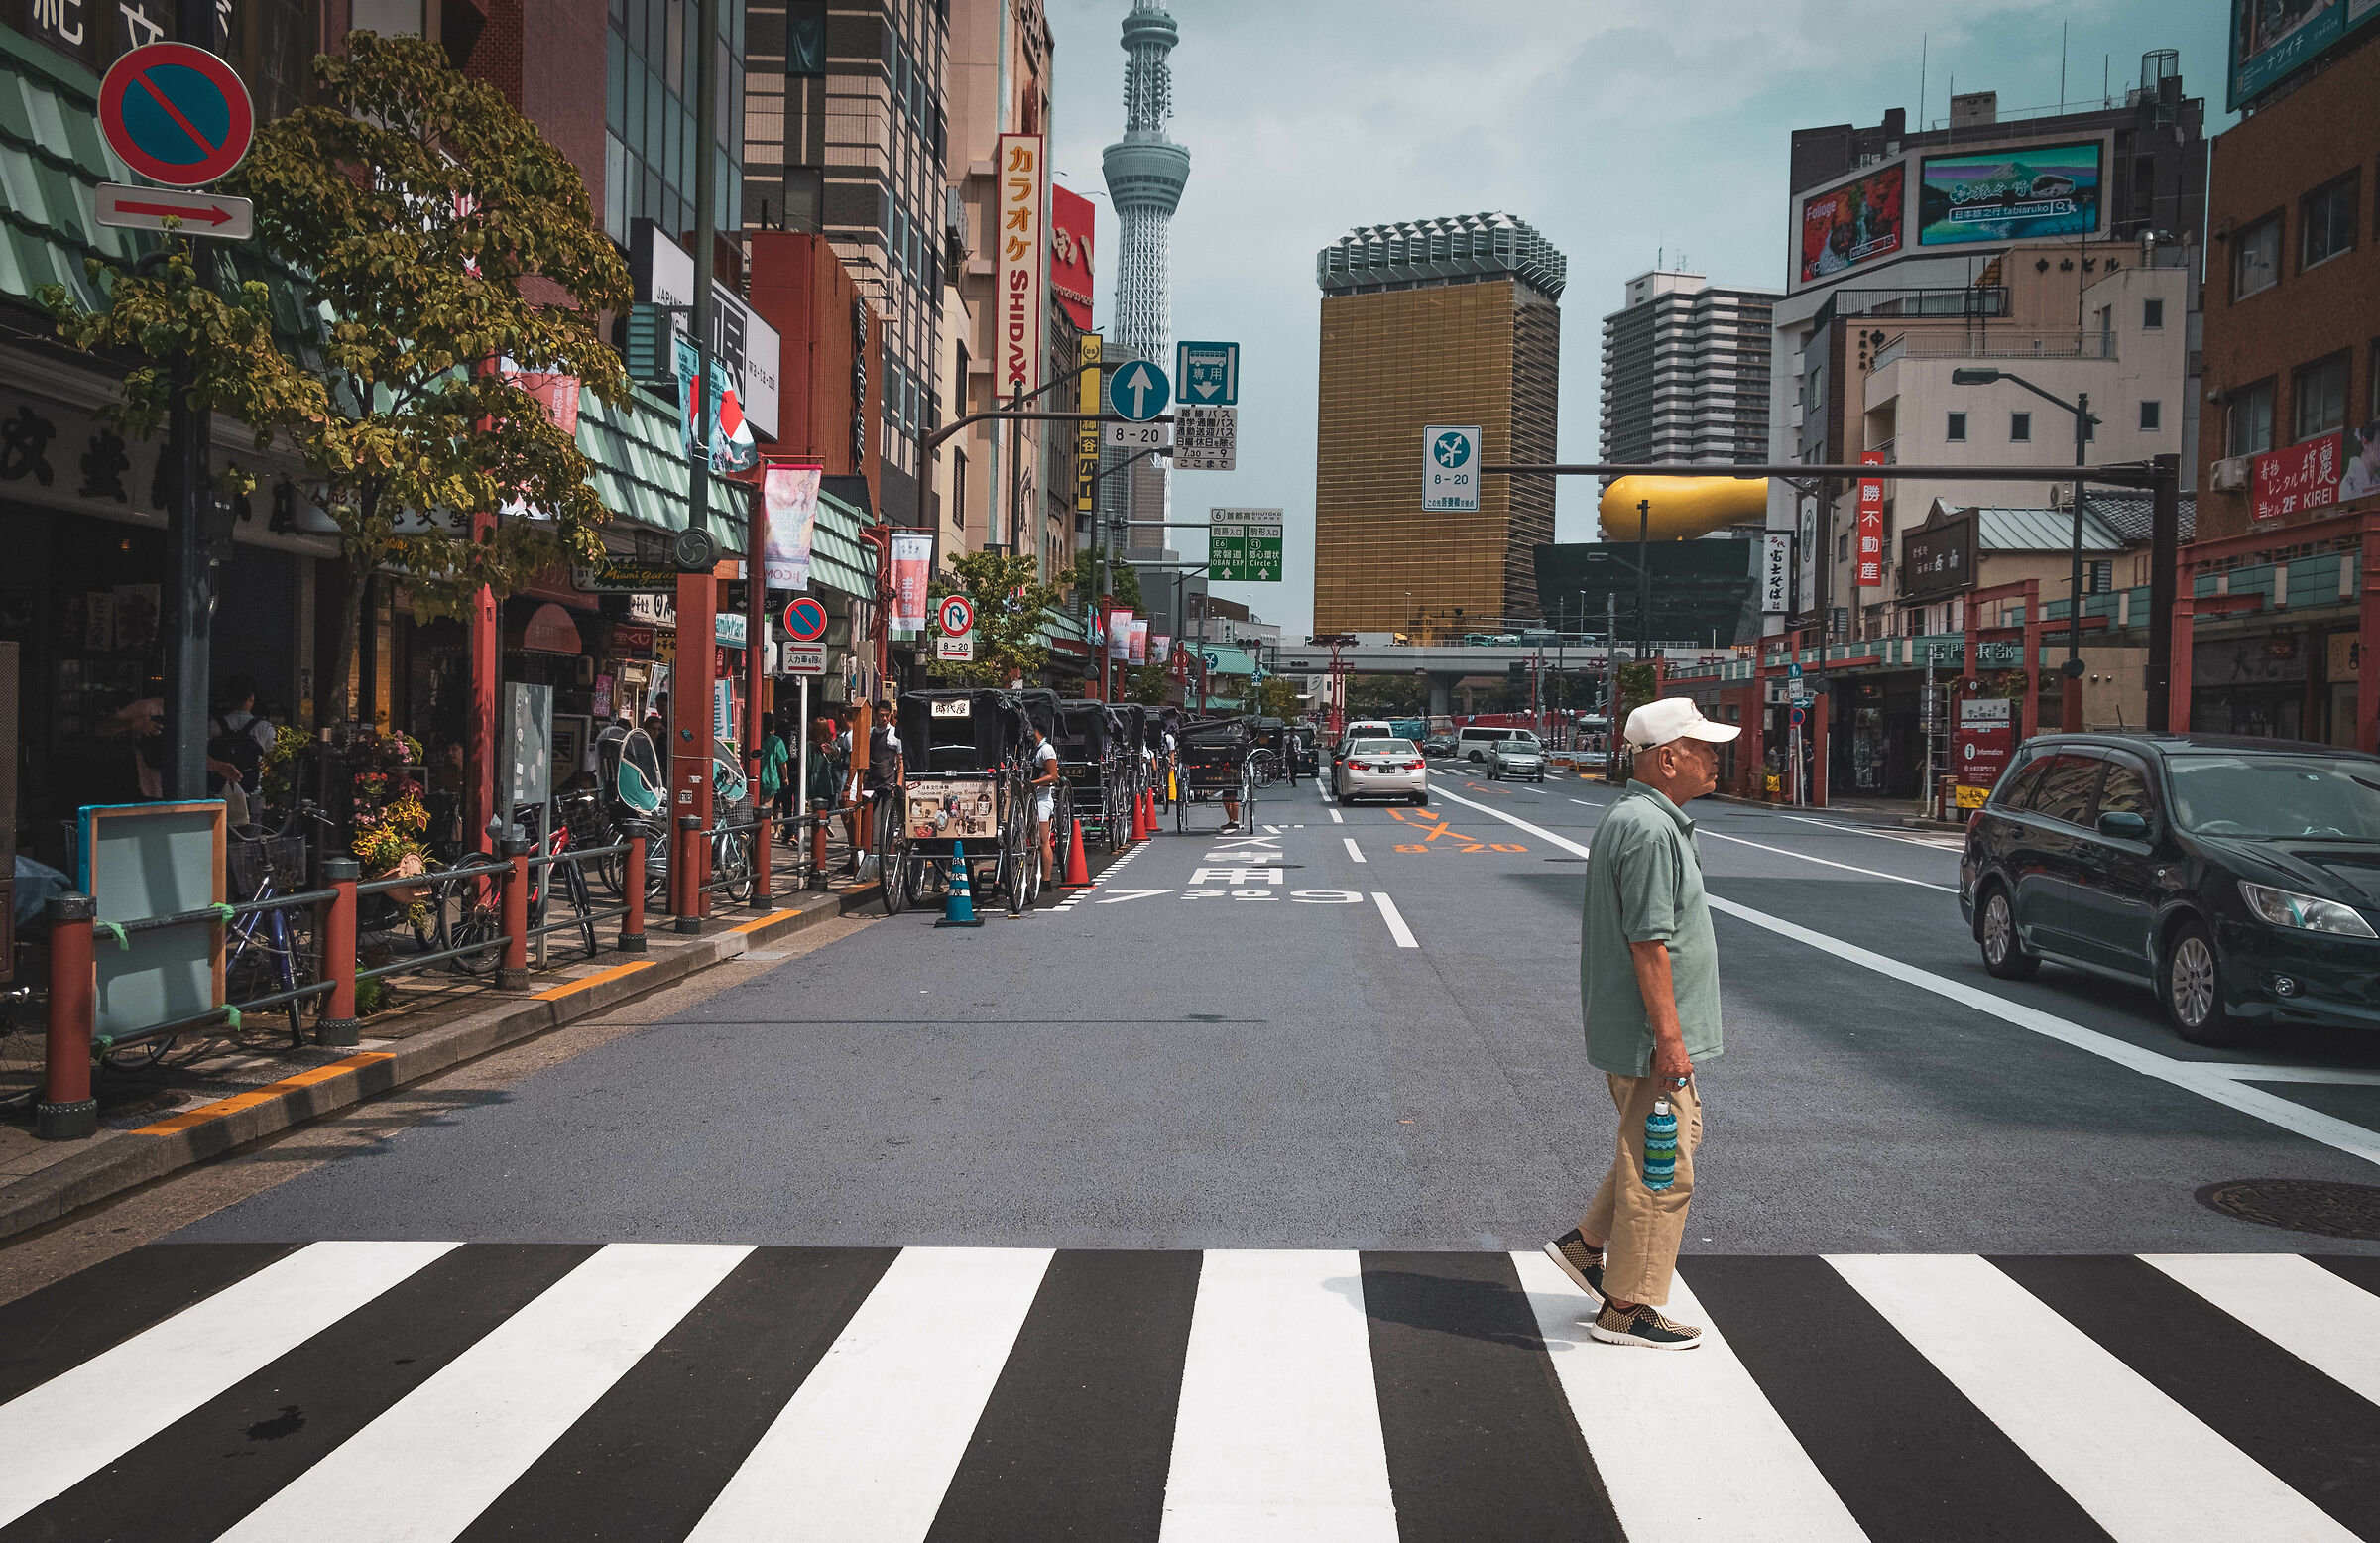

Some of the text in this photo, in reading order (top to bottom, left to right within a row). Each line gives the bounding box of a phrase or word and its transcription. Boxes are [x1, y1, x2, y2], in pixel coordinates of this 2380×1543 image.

[1006, 146, 1033, 262] カラオケ
[2036, 257, 2120, 274] 中山ビル
[1009, 269, 1029, 386] SHIDAX
[1193, 368, 1223, 381] 専用
[1181, 409, 1231, 418] 路線バス
[1180, 460, 1228, 469] ここまで
[2261, 460, 2280, 480] 着物
[2269, 473, 2299, 495] レンタル
[2259, 487, 2332, 518] 当ビル 2F KIREI
[1215, 511, 1221, 520] 6
[1227, 512, 1250, 521] 首都高
[1213, 527, 1242, 536] 向島入口
[1250, 527, 1279, 536] 駒形入口
[1213, 549, 1242, 559] 常磐道
[1250, 550, 1280, 559] 都心環状
[604, 569, 639, 581] Miami
[787, 655, 823, 664] 人力車を除く
[935, 702, 966, 715] 時代屋
